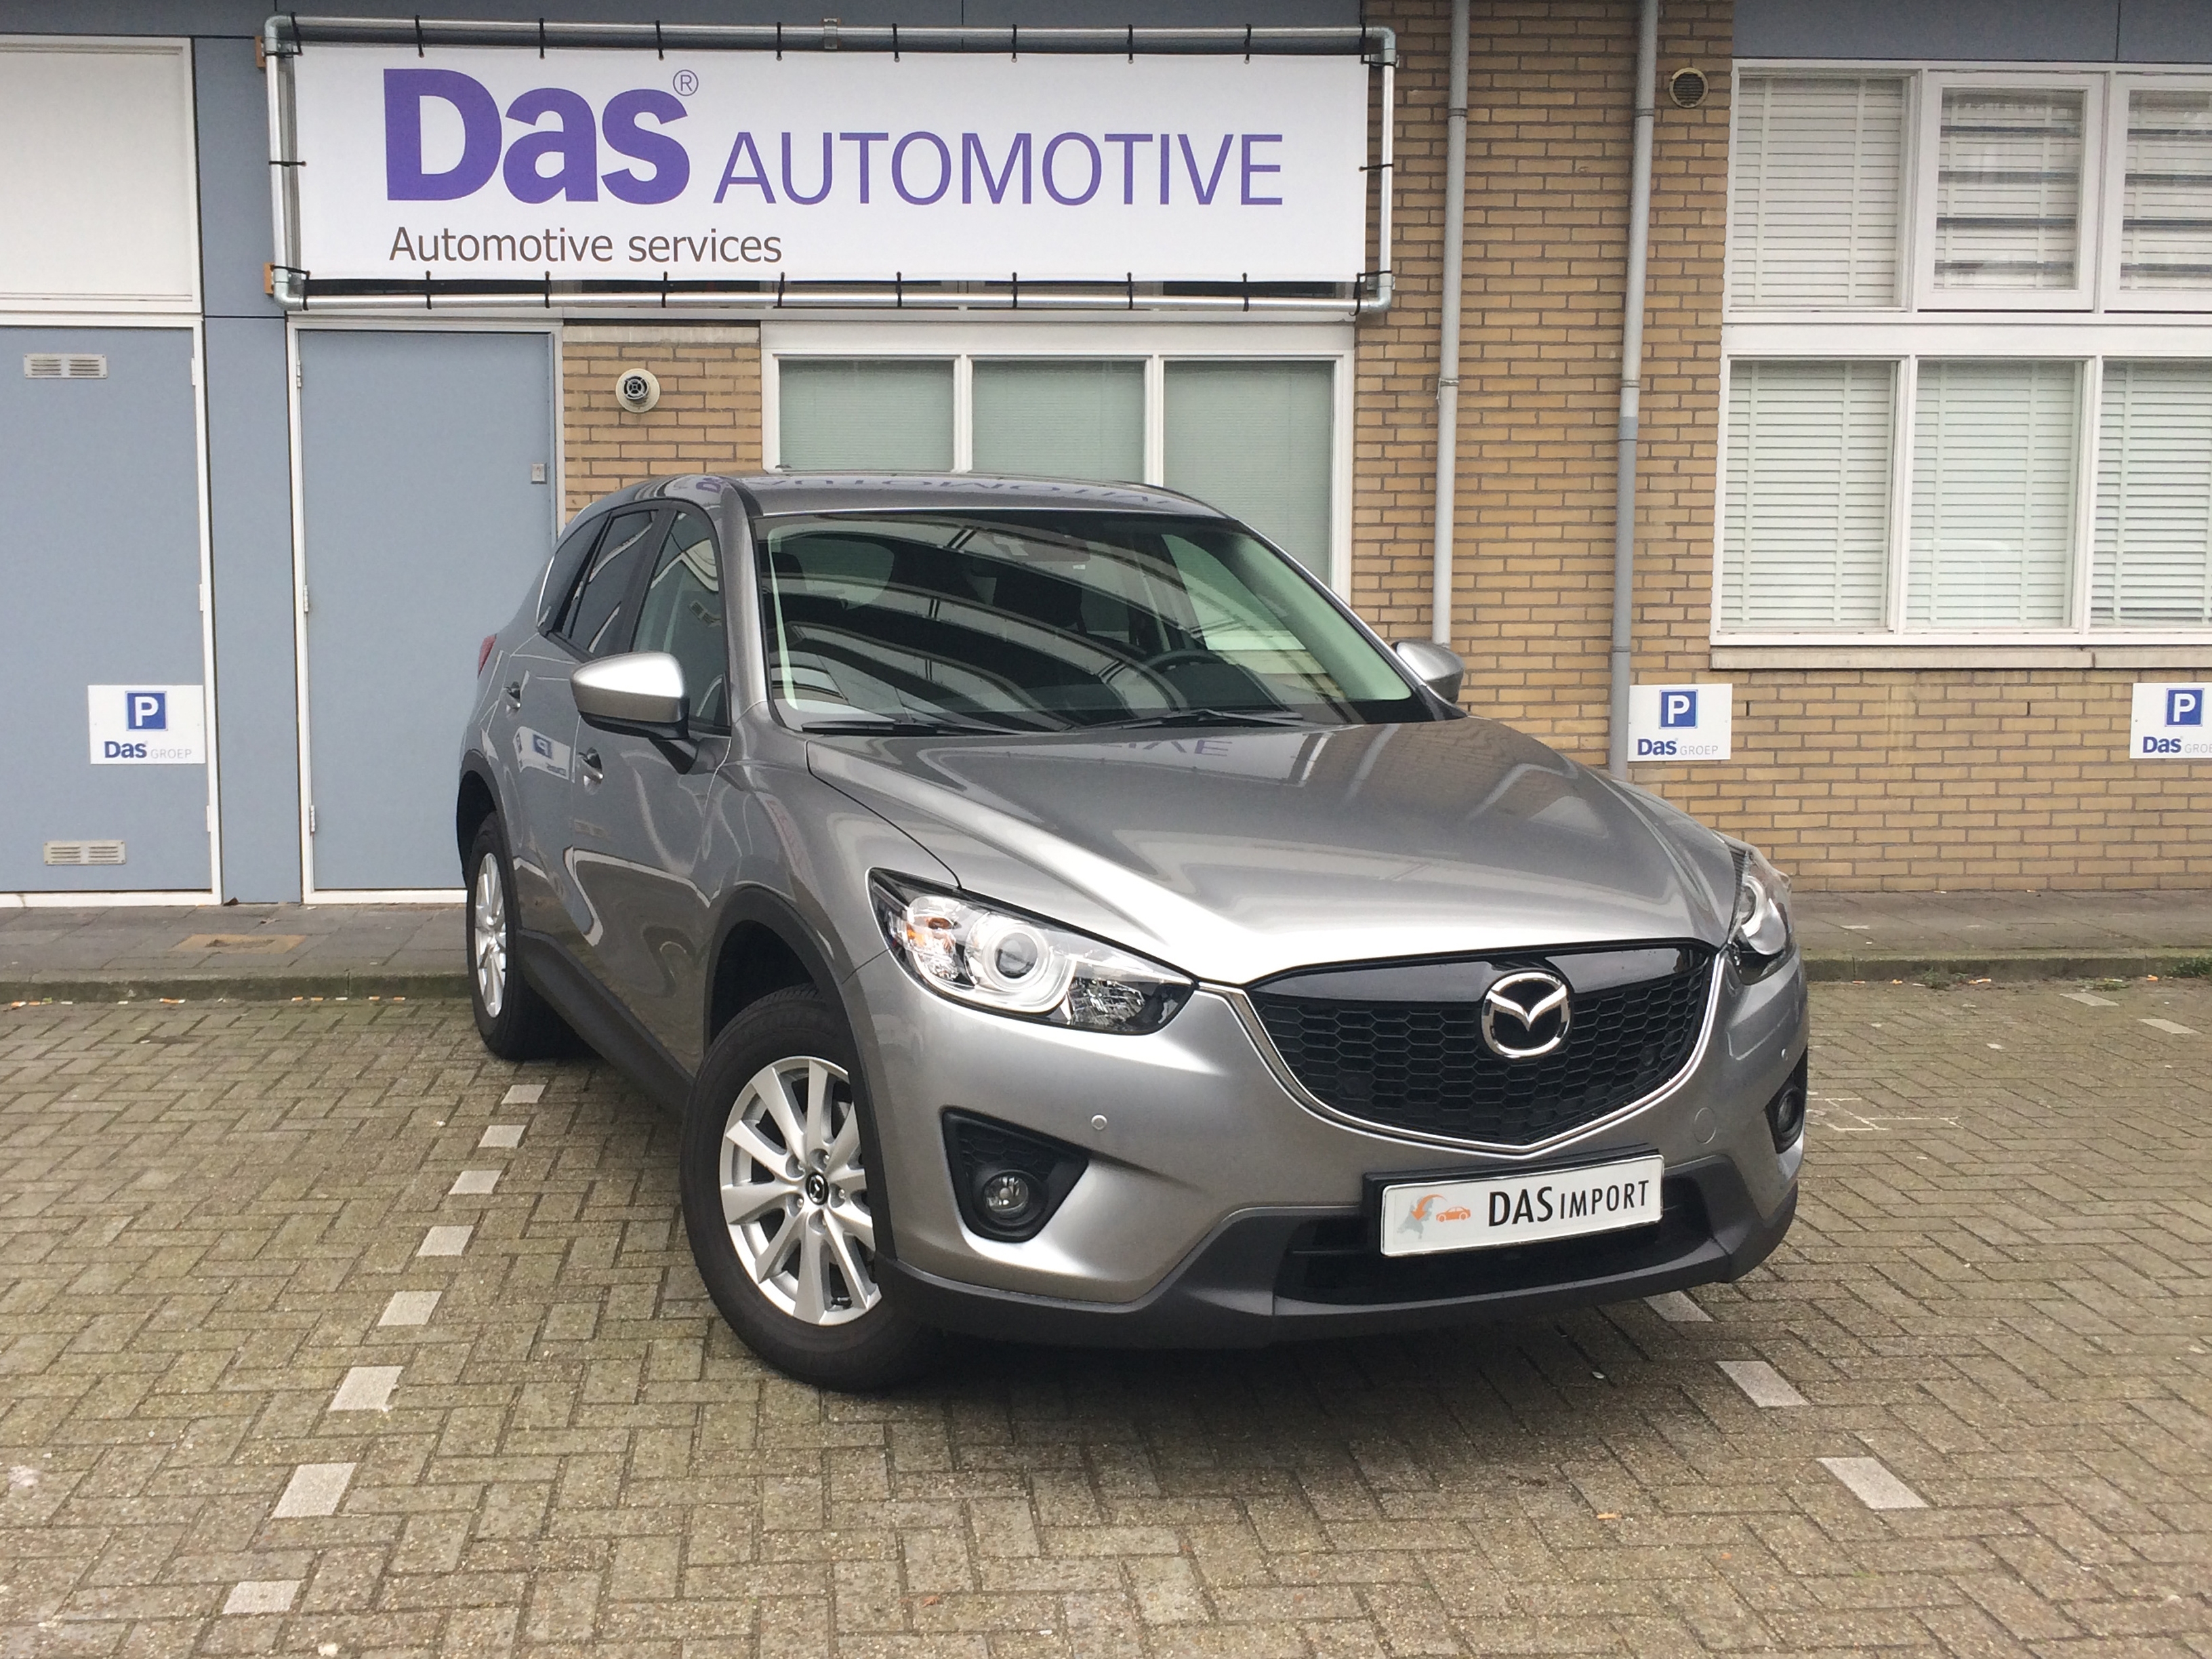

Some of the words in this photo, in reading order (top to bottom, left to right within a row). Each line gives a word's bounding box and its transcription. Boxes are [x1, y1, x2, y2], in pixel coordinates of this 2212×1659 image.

[714, 131, 1282, 205] AUTOMOTIVE
[390, 227, 613, 262] Automotive
[629, 228, 782, 263] services
[135, 696, 159, 726] P
[1668, 695, 1690, 724] P
[2173, 693, 2196, 722] P
[104, 741, 147, 758] Das
[150, 749, 192, 759] GROEP
[1637, 738, 1677, 756] Das
[1679, 745, 1719, 756] GROEP
[2142, 736, 2182, 754] Das
[2184, 743, 2212, 754] GROE
[1488, 1186, 1553, 1227] DAS
[1560, 1180, 1650, 1219] IMPORT
